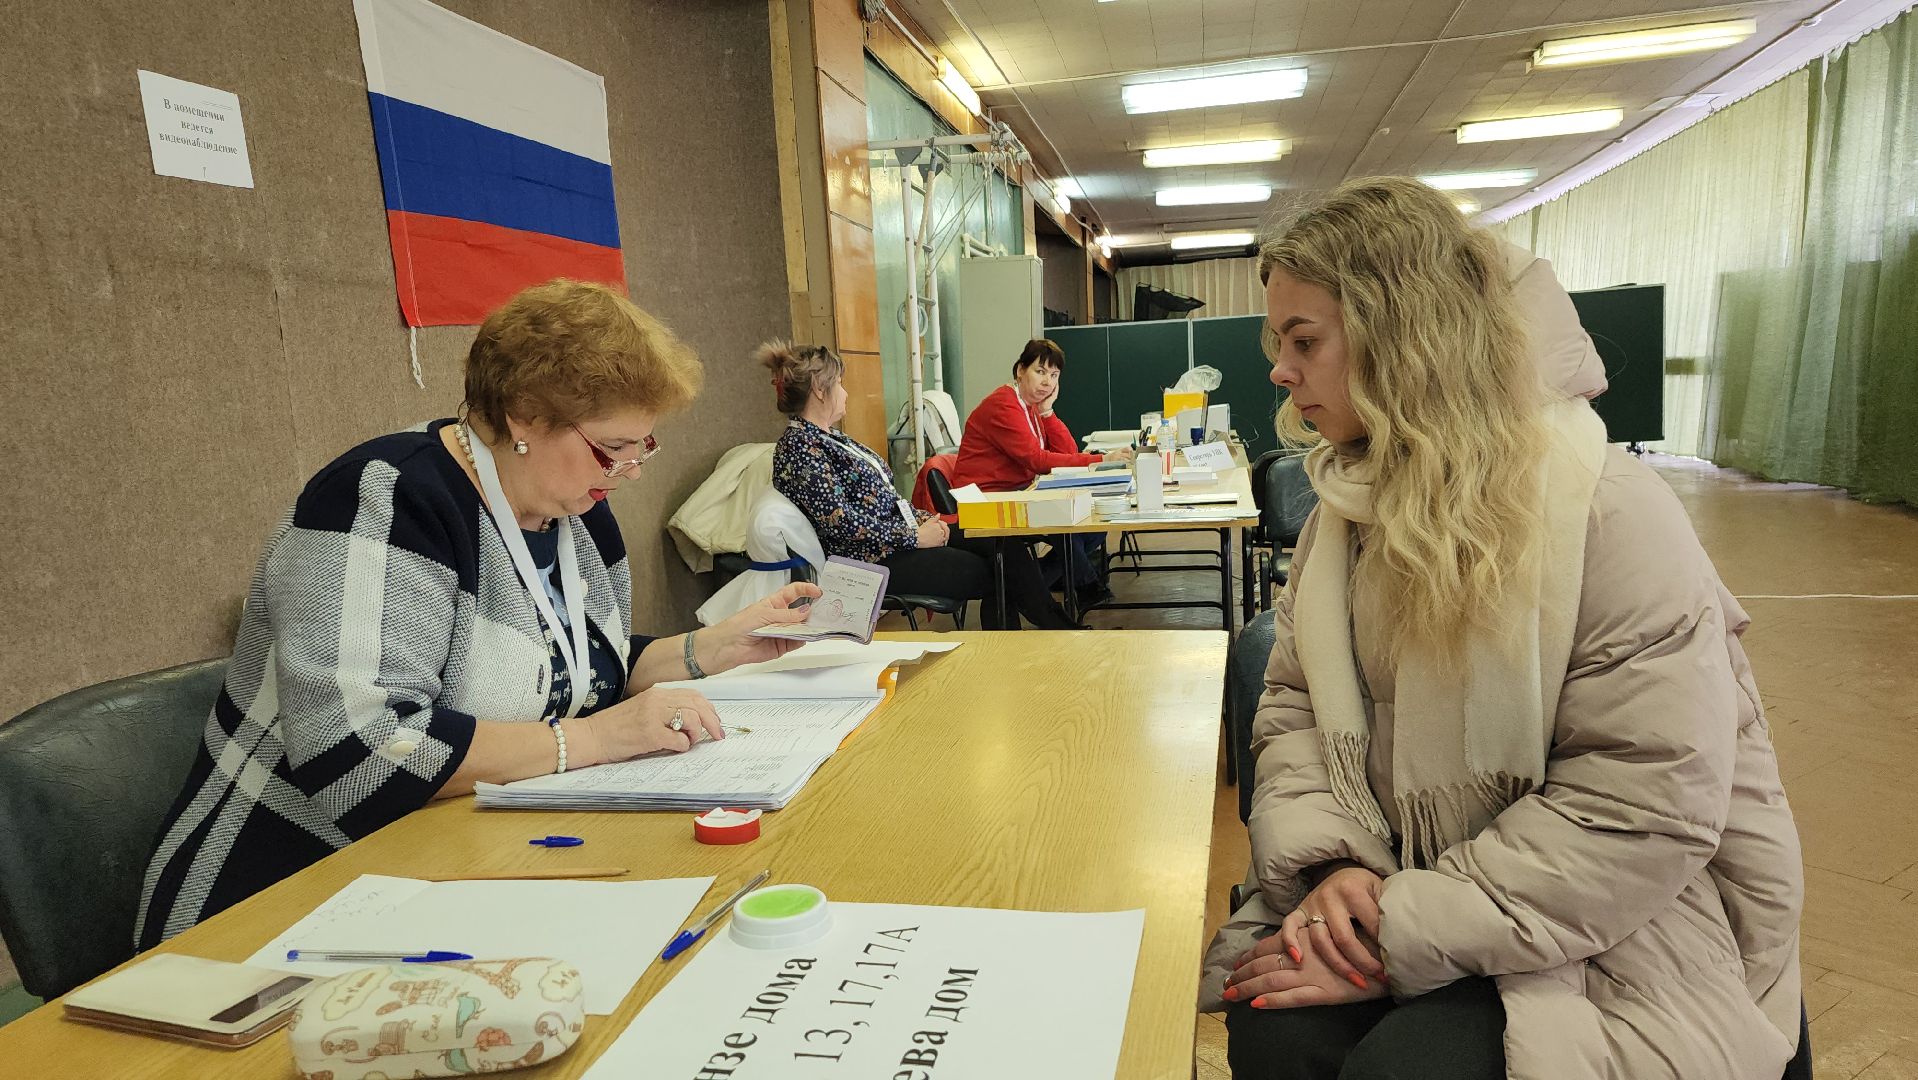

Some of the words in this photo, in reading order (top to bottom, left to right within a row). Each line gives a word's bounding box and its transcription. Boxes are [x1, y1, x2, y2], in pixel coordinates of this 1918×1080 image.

[163, 98, 171, 109] В
[174, 103, 225, 122] помещении
[181, 120, 214, 135] ведется
[159, 133, 238, 155] видеонаблюдение
[740, 957, 818, 1025] дома
[924, 967, 979, 1024] дом
